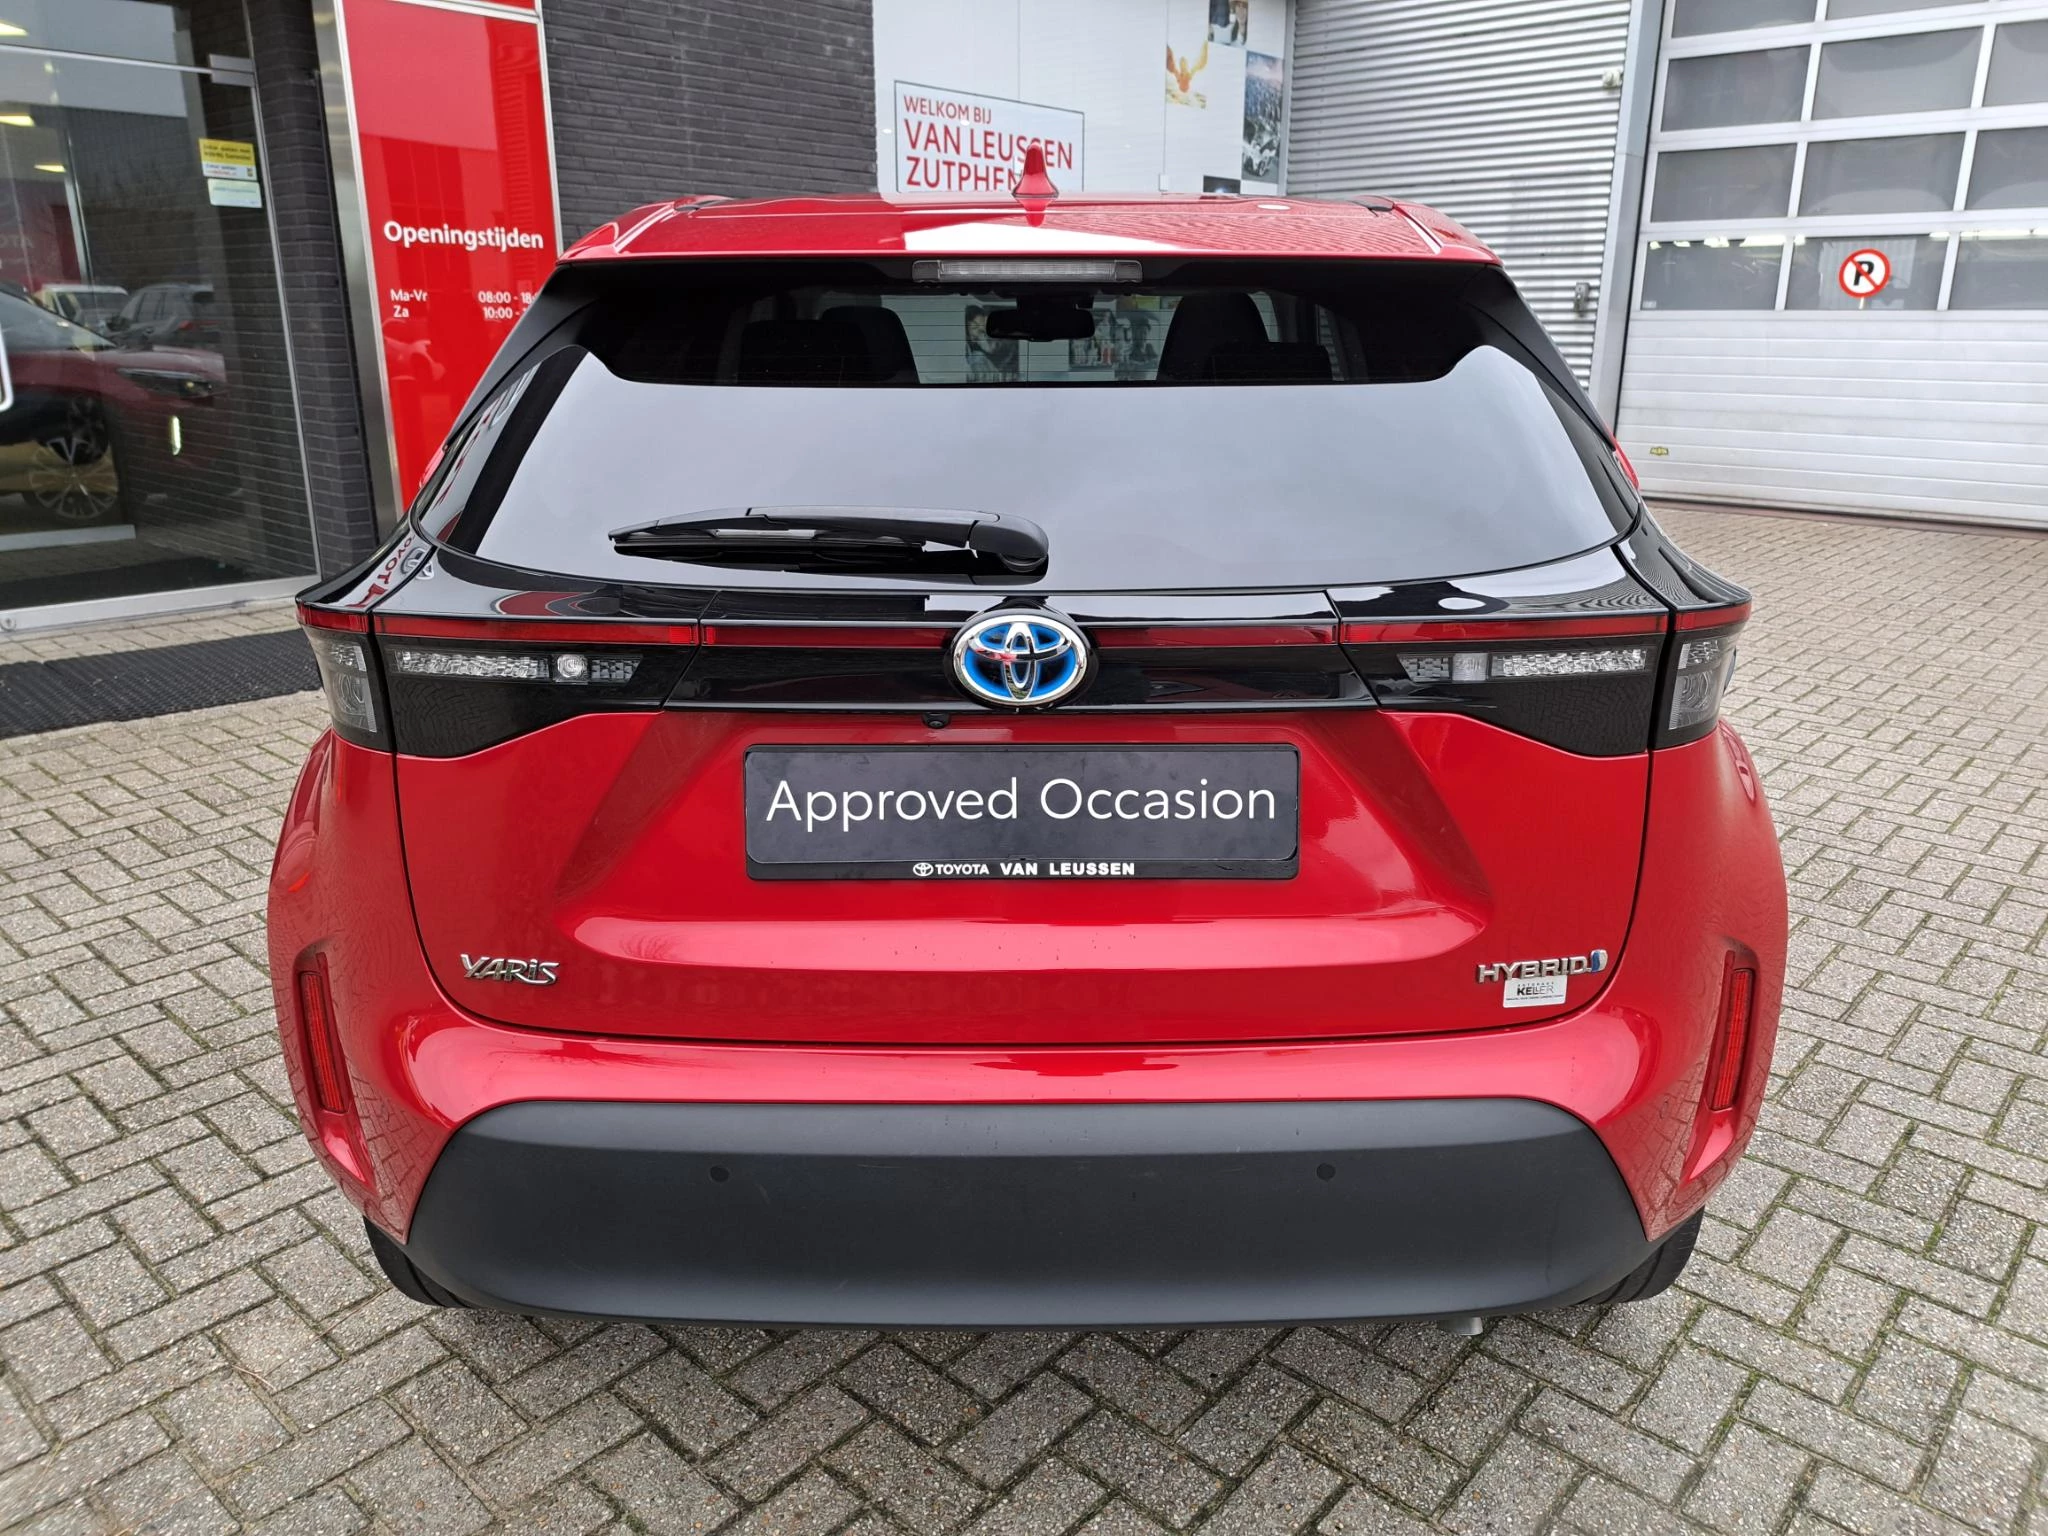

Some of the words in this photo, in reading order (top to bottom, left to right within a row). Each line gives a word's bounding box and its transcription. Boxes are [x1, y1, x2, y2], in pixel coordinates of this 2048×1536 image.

[904, 95, 969, 121] WELKOM
[973, 106, 992, 124] BIJ
[904, 119, 960, 156] VAN
[970, 128, 1072, 170] LEUSEN
[384, 221, 543, 252] Openingstijden
[1853, 260, 1875, 286] P
[390, 289, 428, 302] Ma-Vr
[478, 291, 511, 304] 08:00
[393, 305, 409, 318] Za
[484, 306, 513, 319] 10:00
[766, 777, 1018, 832] Approved
[1041, 777, 1276, 820] Occasion
[936, 863, 990, 875] TOYOTA
[1000, 862, 1038, 876] VAN
[1049, 862, 1135, 876] LEUSSEN
[1478, 956, 1588, 983] HYBRID
